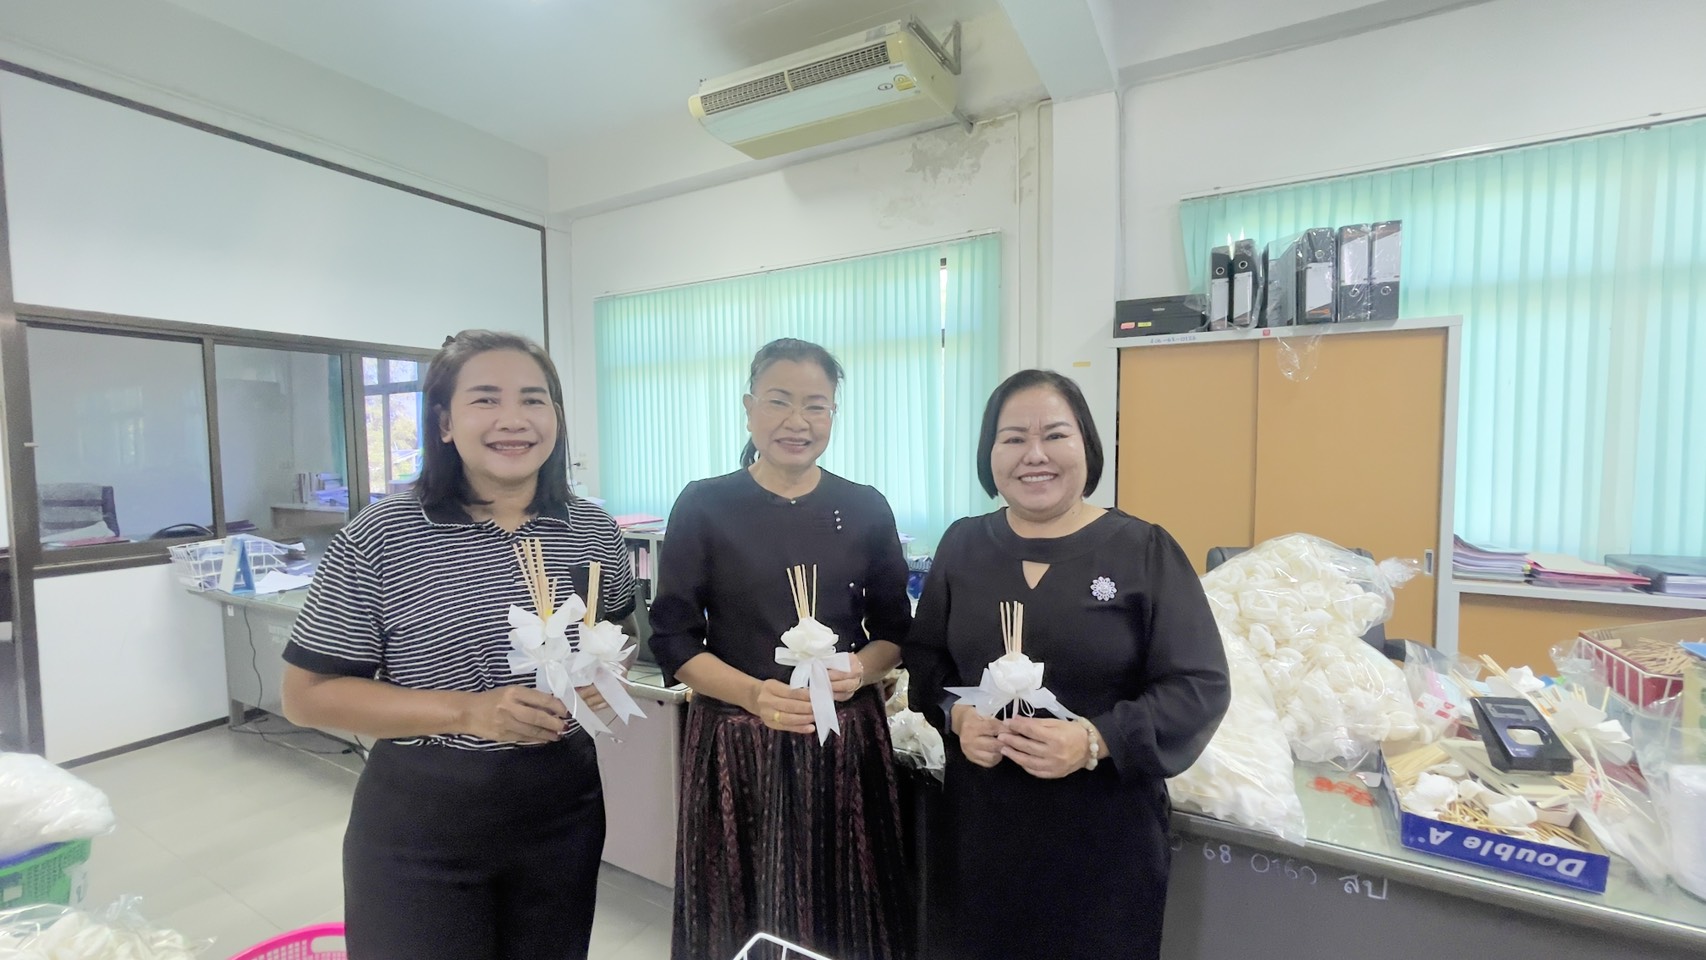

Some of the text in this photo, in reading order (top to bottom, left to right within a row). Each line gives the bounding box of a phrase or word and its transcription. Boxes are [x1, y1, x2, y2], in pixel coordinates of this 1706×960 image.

[1203, 842, 1232, 863] 68
[1429, 826, 1586, 878] Double A
